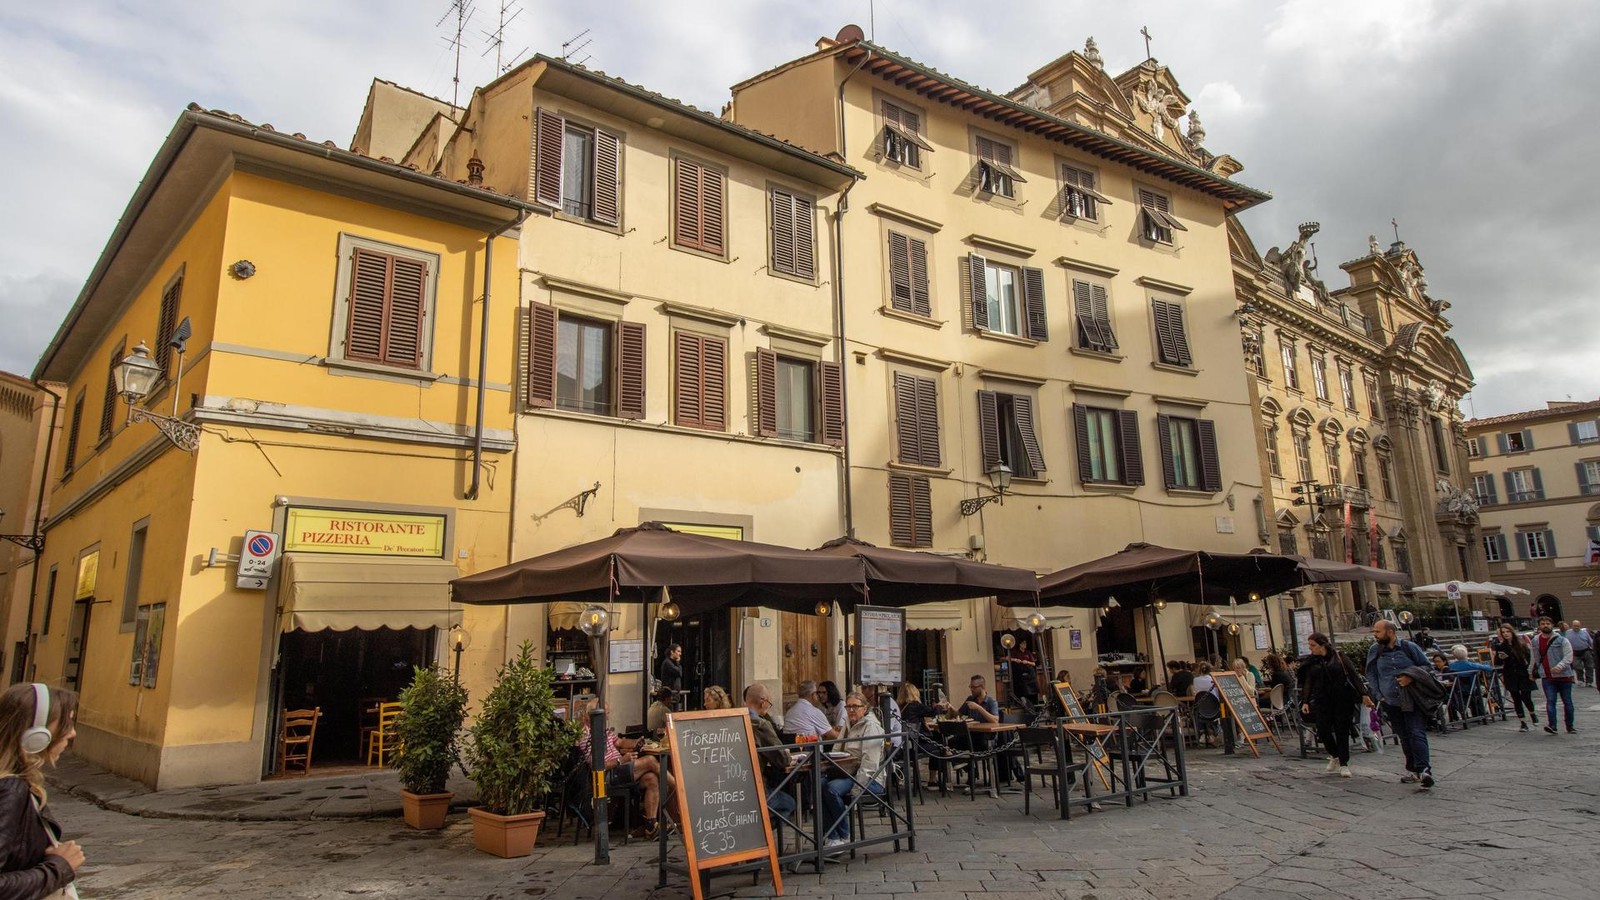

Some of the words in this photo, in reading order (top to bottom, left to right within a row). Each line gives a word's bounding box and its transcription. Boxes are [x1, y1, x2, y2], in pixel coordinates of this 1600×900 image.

[329, 520, 425, 535] RISTORANTE
[301, 531, 371, 545] PIZZERIA
[691, 746, 736, 764] STEAK
[703, 790, 745, 805] POTATOES
